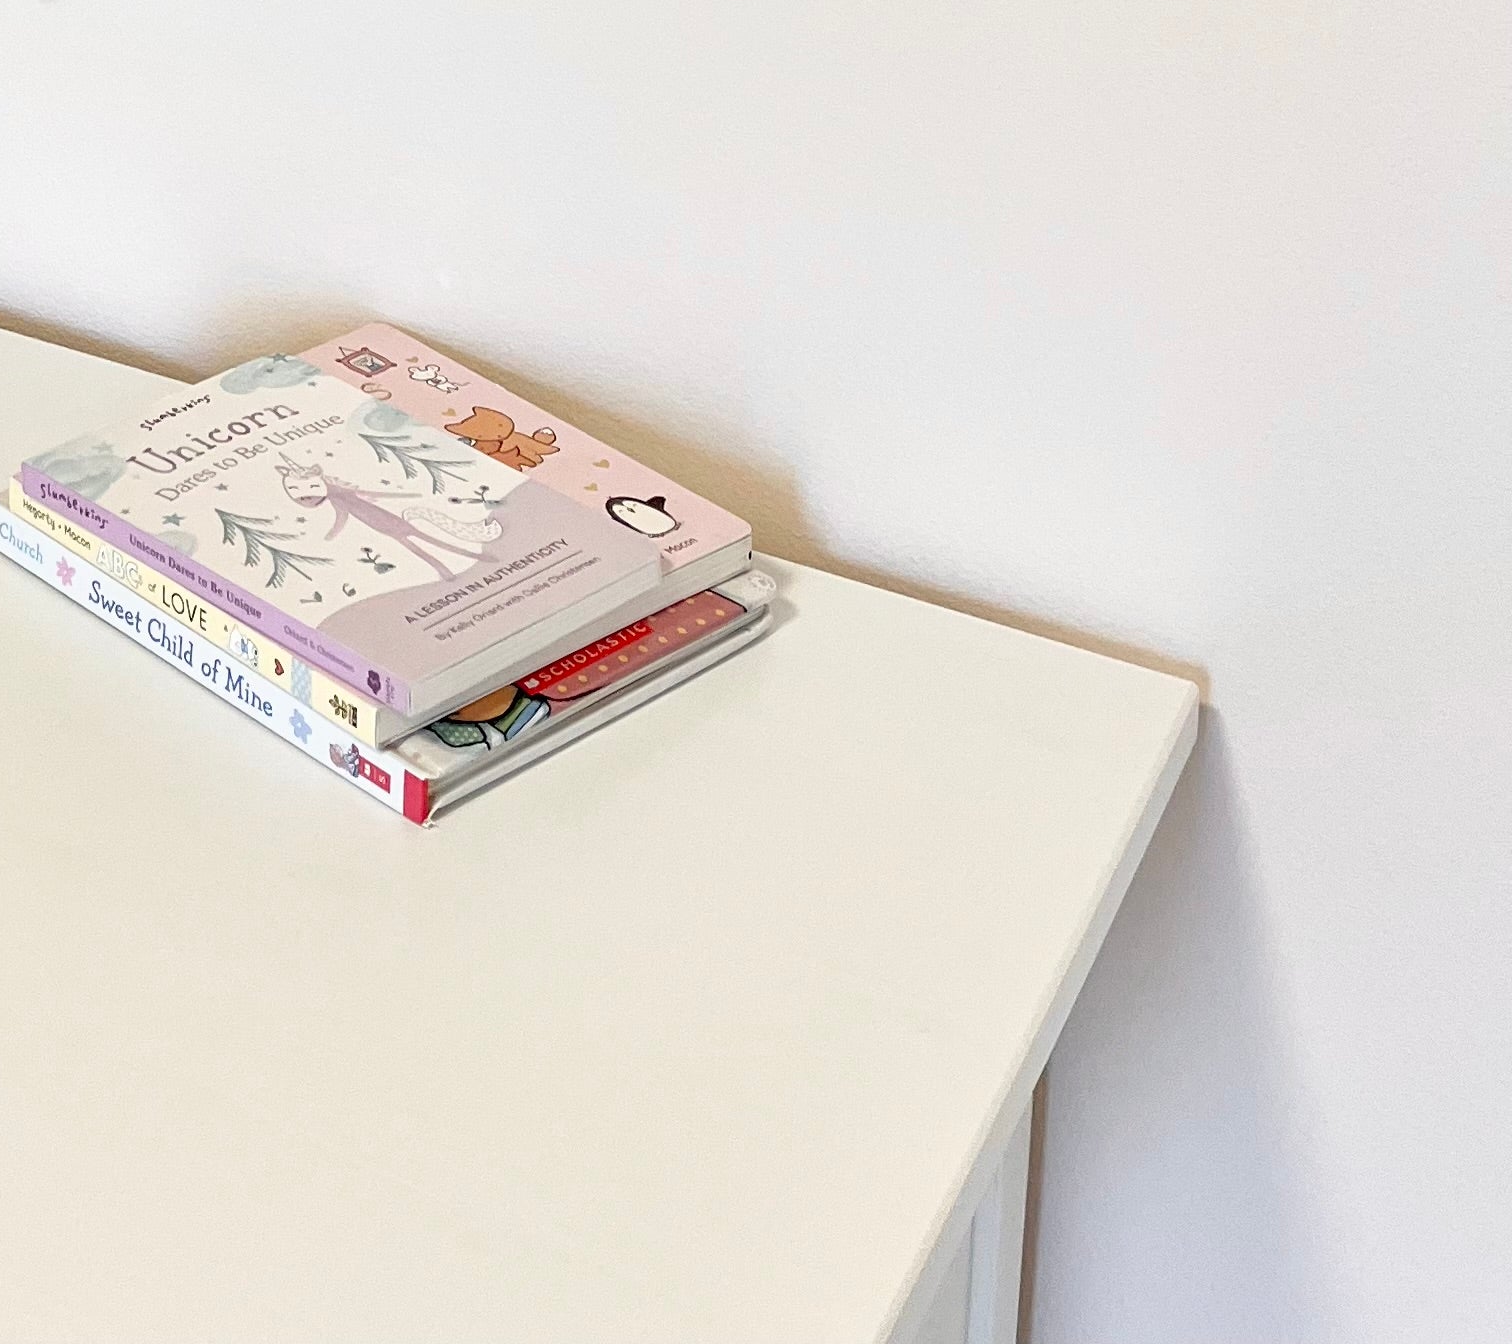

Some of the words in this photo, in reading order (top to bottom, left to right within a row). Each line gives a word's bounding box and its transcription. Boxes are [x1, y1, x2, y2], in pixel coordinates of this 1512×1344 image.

[126, 404, 300, 474] Unicorn
[155, 466, 217, 502] Dares
[213, 455, 238, 471] to
[233, 443, 269, 460] Be
[263, 414, 345, 446] Unique
[64, 525, 91, 550] Macon
[162, 584, 207, 631] LOVE
[129, 533, 166, 563] Unicorn
[168, 556, 195, 580] Dares
[198, 575, 208, 588] to
[210, 581, 224, 597] Be
[226, 590, 263, 619] Unique
[404, 615, 418, 624] A
[414, 588, 468, 618] LESSON
[466, 581, 484, 593] IN
[482, 538, 569, 586] AUTHENTICITY
[664, 536, 698, 555] Macon
[88, 580, 141, 633] Sweet
[147, 618, 194, 667] Child
[201, 659, 221, 683] of
[224, 667, 273, 717] Mine
[541, 622, 647, 682] SCHOLASTIC
